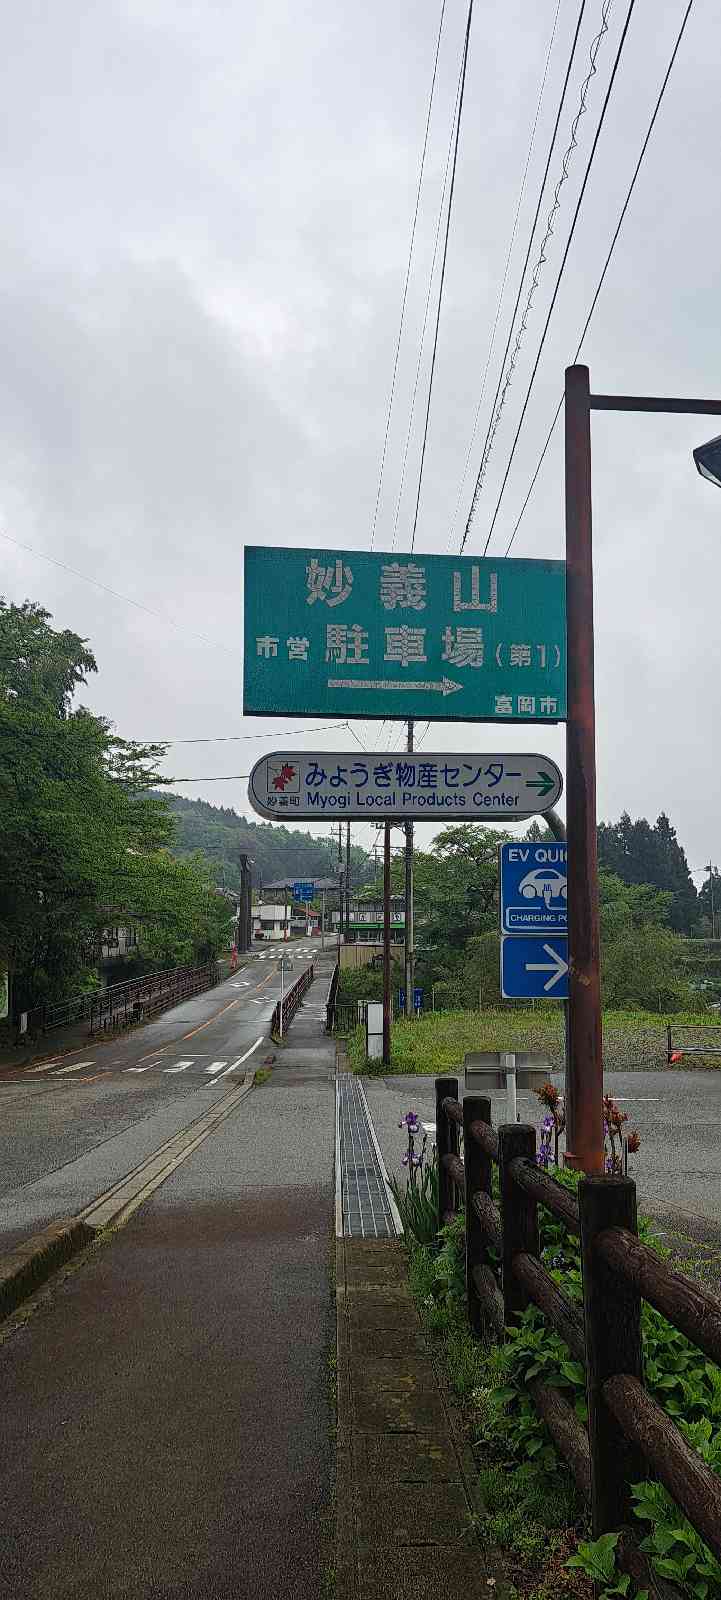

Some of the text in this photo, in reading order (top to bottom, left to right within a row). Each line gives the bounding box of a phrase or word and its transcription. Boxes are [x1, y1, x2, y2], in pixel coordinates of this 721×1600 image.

[305, 558, 498, 613] 妙義山
[255, 635, 310, 662] 市営
[324, 624, 485, 668] 駐車場
[494, 695, 558, 714] 富岡市
[305, 762, 522, 788] みょうぎ物産センター
[307, 791, 520, 808] Myogi Local Products Center
[508, 848, 568, 863] EV QUI
[510, 914, 556, 922] CHARGING
